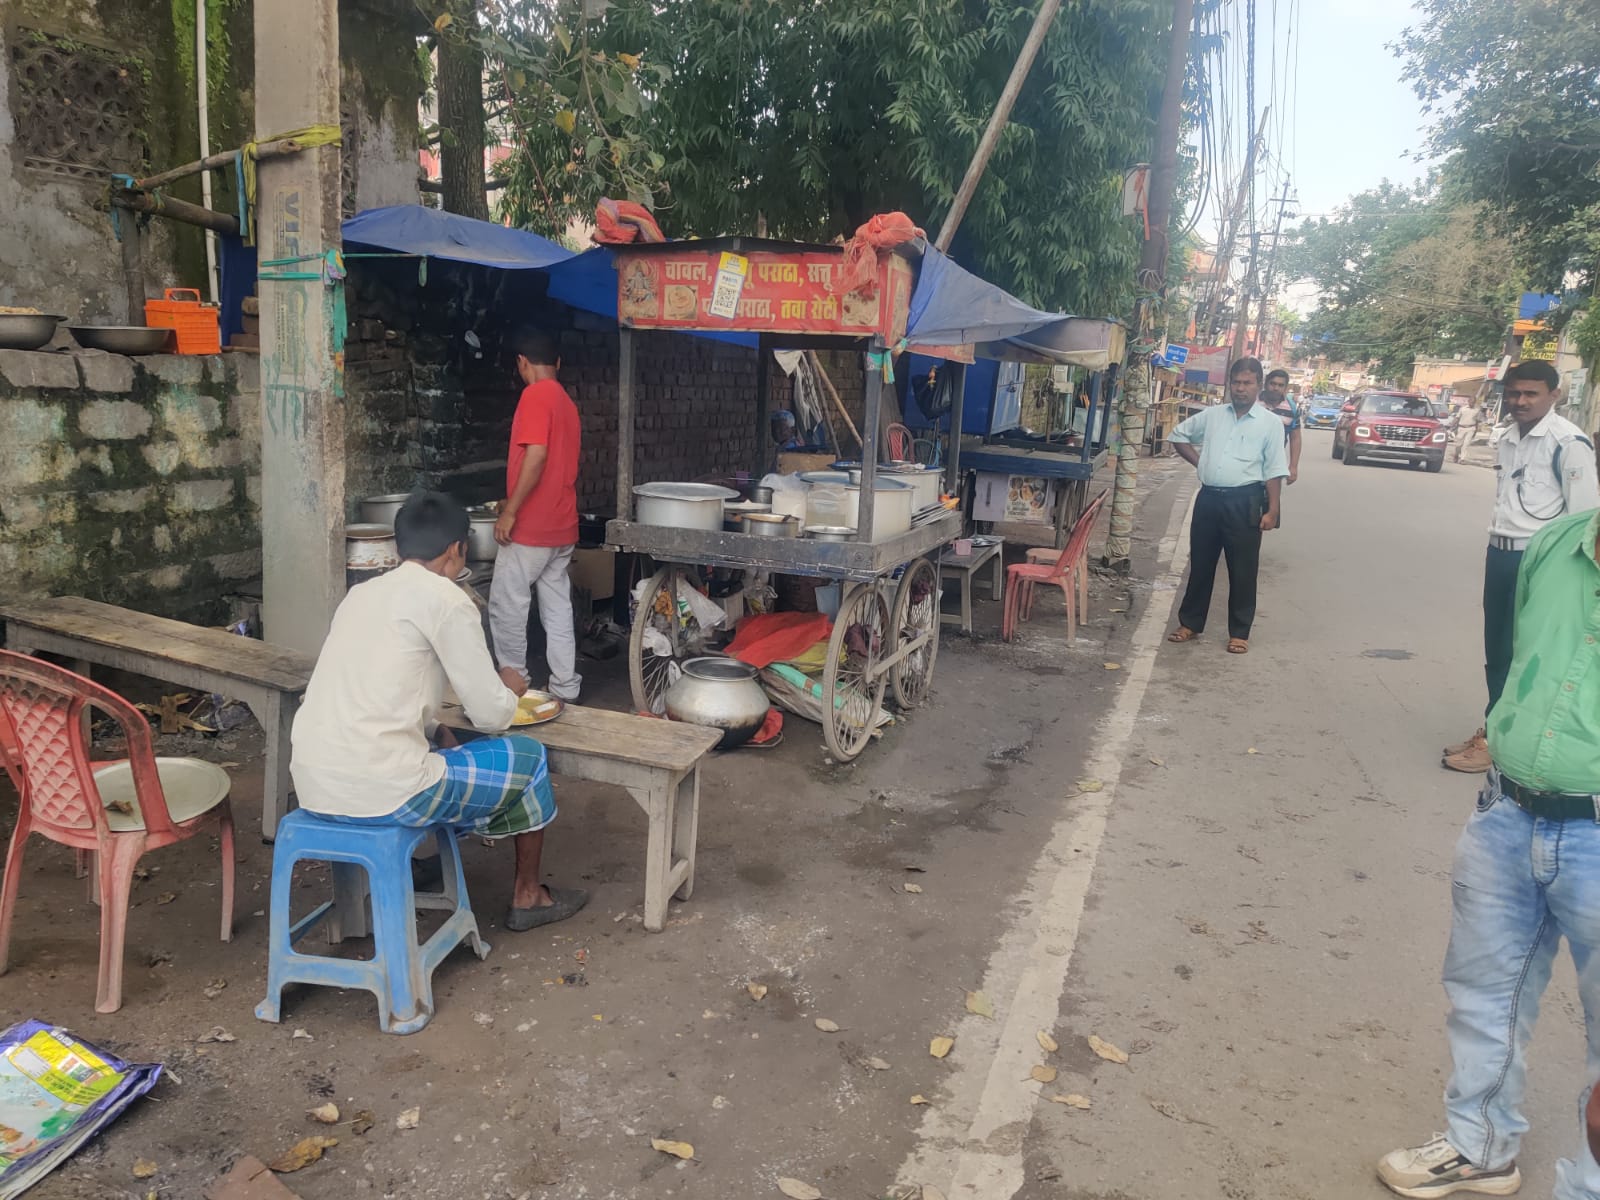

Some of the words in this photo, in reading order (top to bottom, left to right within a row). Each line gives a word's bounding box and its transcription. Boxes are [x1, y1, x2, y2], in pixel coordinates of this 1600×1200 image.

[665, 261, 713, 285] चावल,
[758, 263, 804, 287] पराठा,
[781, 300, 807, 320] तवा
[811, 294, 838, 321] रोटी
